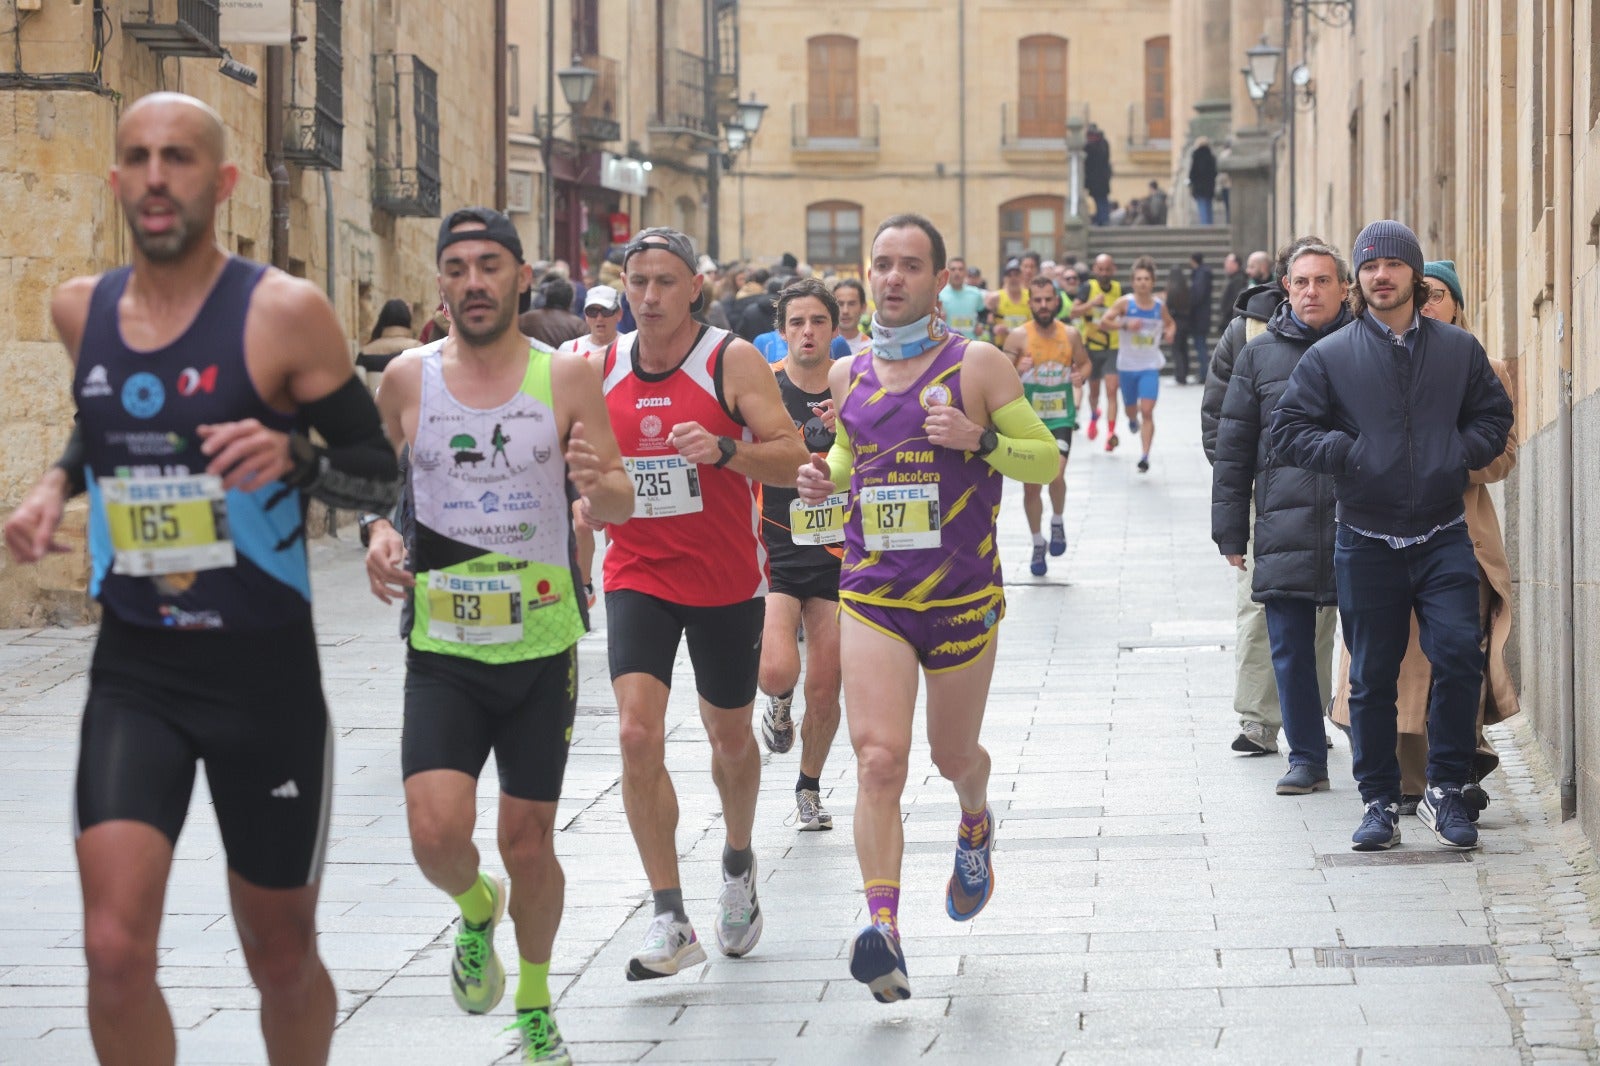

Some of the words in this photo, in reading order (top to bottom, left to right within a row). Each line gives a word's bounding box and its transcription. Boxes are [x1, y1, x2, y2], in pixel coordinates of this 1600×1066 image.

[895, 450, 934, 463] PRIM
[636, 458, 688, 471] SETEL
[447, 467, 459, 479] La
[887, 470, 941, 483] Macotera
[129, 481, 205, 500] SETEL
[634, 472, 671, 497] 235
[508, 491, 533, 500] AZUL
[876, 488, 930, 501] SETEL
[442, 501, 477, 510] AMTEL
[502, 501, 541, 511] TELECO
[804, 508, 833, 529] 207
[876, 503, 906, 529] 137
[128, 503, 180, 543] 165
[478, 534, 524, 546] TELECOM
[449, 578, 511, 592] SETEL
[453, 594, 481, 620] 63
